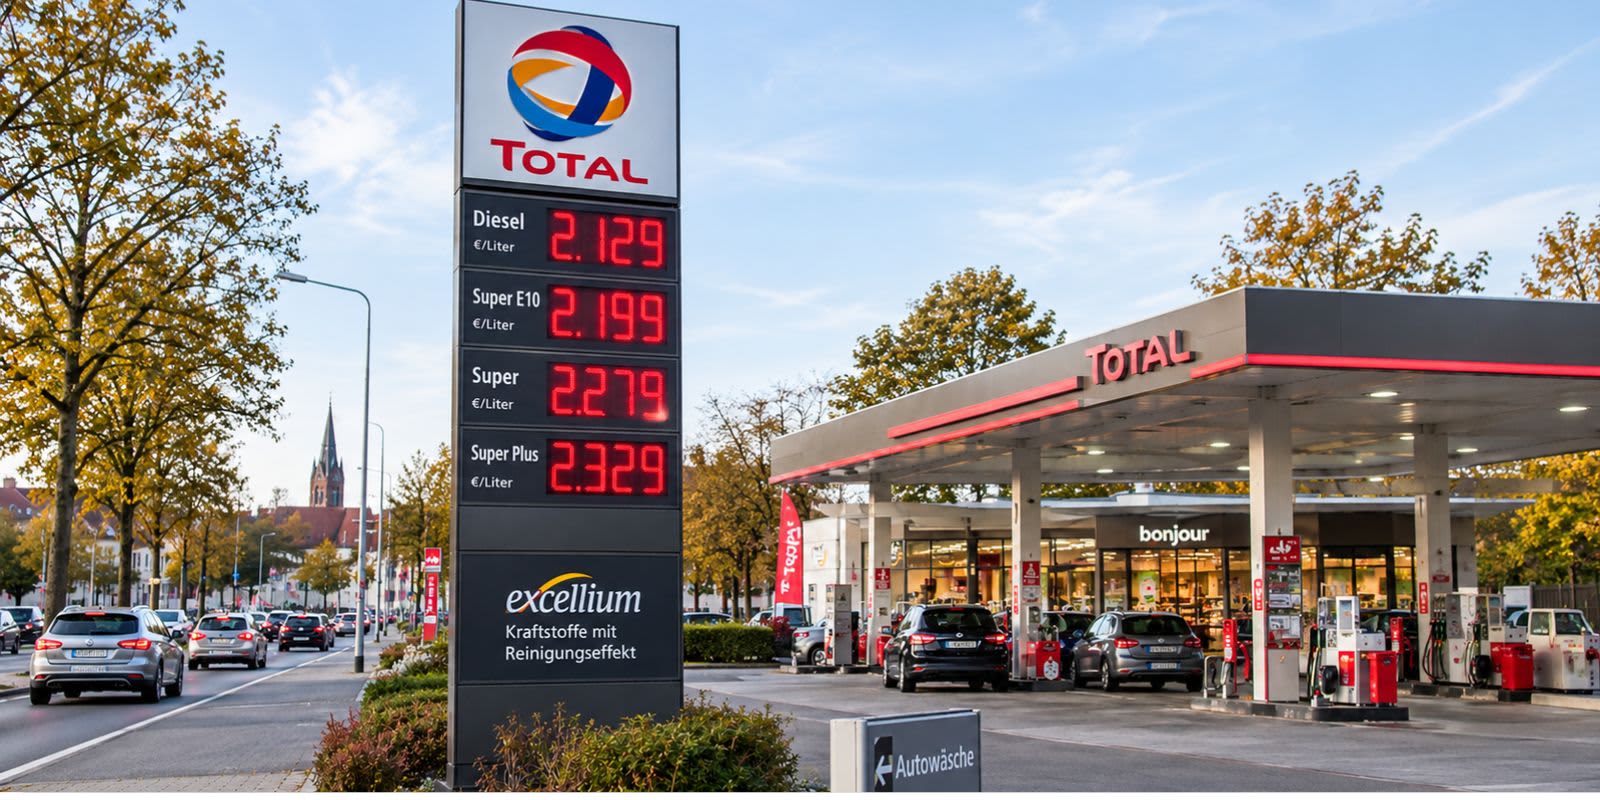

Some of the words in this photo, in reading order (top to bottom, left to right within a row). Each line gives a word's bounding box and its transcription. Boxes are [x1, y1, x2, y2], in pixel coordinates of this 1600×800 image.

[490, 138, 648, 185] TOTAL
[473, 209, 525, 230] Diesel
[473, 239, 515, 253] €/Liter
[551, 211, 664, 268] 2.129
[472, 287, 513, 309] Super
[516, 290, 541, 308] E10
[472, 317, 515, 331] €/Liter
[551, 287, 664, 344] 2.199
[1085, 328, 1195, 385] TOTAL
[472, 366, 520, 389] Super
[471, 397, 514, 410] €/Liter
[551, 365, 667, 422] 2.279
[471, 443, 509, 465] Super
[512, 445, 539, 462] Plus
[551, 441, 665, 494] 2.329
[470, 475, 513, 489] €/Liter
[1139, 524, 1210, 547] bonjour
[505, 582, 642, 614] excellium
[505, 623, 588, 639] Kraftstoffe
[592, 624, 617, 639] mit
[505, 645, 637, 664] Reinigungseffekt
[895, 745, 975, 779] Autowäsche
